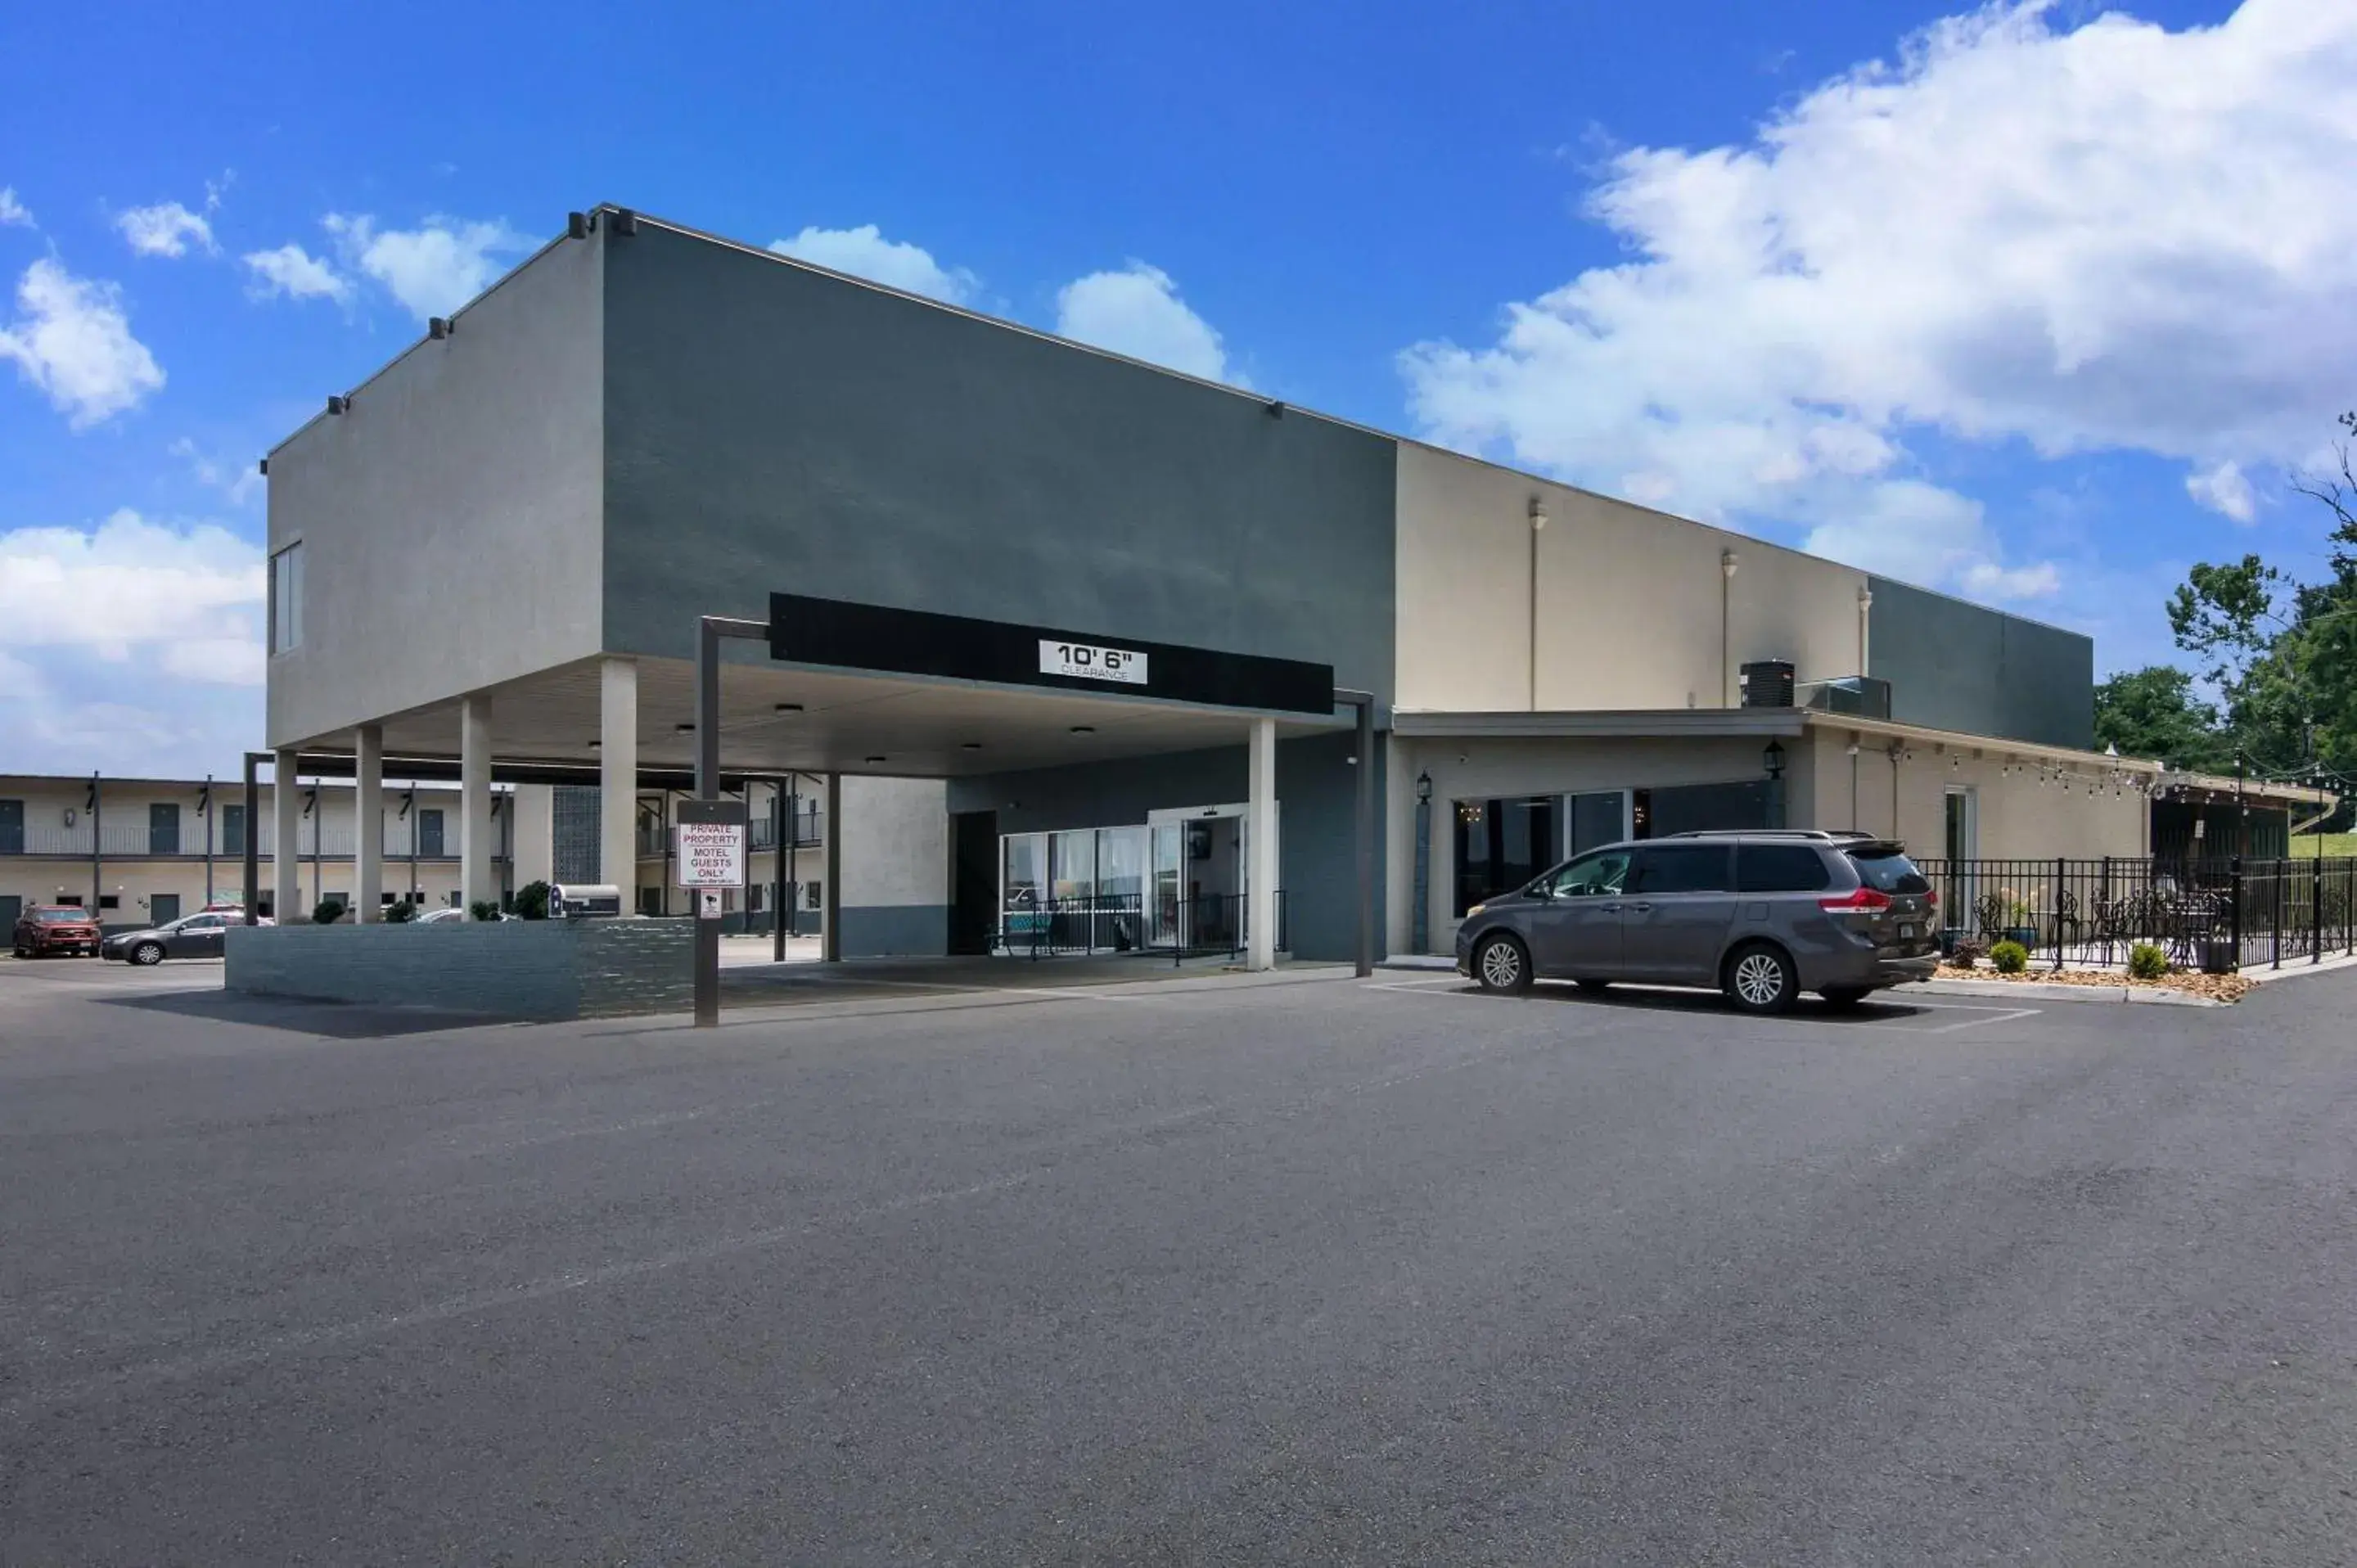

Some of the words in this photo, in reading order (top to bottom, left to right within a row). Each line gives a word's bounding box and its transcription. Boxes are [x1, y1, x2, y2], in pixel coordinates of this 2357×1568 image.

[1057, 645, 1097, 665] 10'
[1105, 651, 1133, 669] 6"
[1061, 664, 1129, 681] CLEARANCE
[691, 824, 732, 833] PRIVATE
[683, 835, 738, 844] PROPERTY
[694, 848, 730, 857] MOTEL
[691, 858, 732, 867] GUESTS
[697, 868, 725, 877] ONLY
